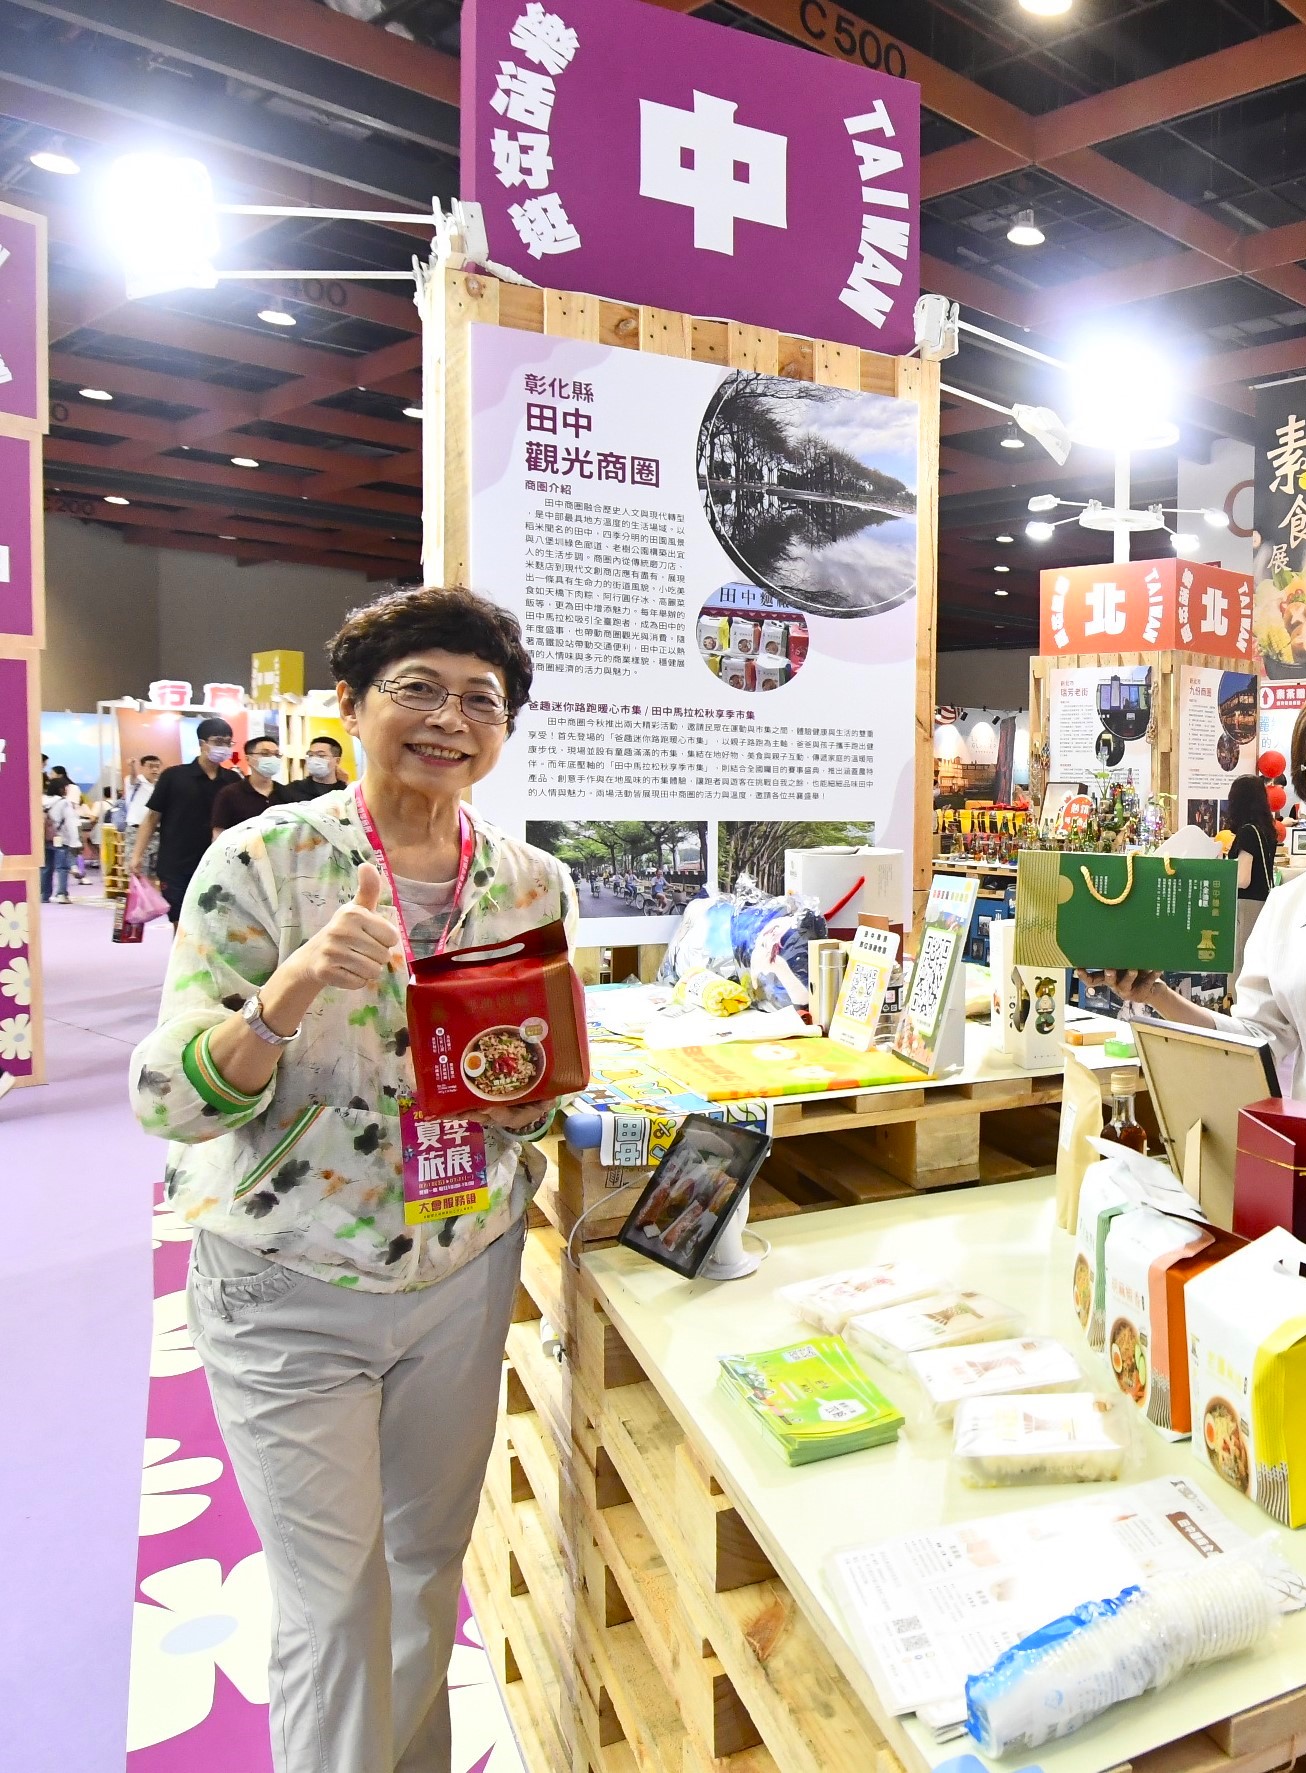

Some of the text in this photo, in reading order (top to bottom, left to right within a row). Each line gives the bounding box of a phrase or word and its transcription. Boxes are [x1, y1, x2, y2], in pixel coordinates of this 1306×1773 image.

[639, 89, 788, 256] 中
[838, 98, 910, 329] TAIWAN
[524, 372, 595, 404] 彰化縣
[525, 402, 593, 440] 田中
[524, 440, 661, 488] 觀光商圈
[524, 479, 572, 496] 商圈介紹
[1084, 582, 1126, 637] 北
[1142, 567, 1164, 644] TAIWAN
[1201, 586, 1229, 636] 北
[415, 1119, 471, 1151] 夏季
[417, 1144, 473, 1182] 旅展
[419, 1193, 477, 1214] 大會服務證
